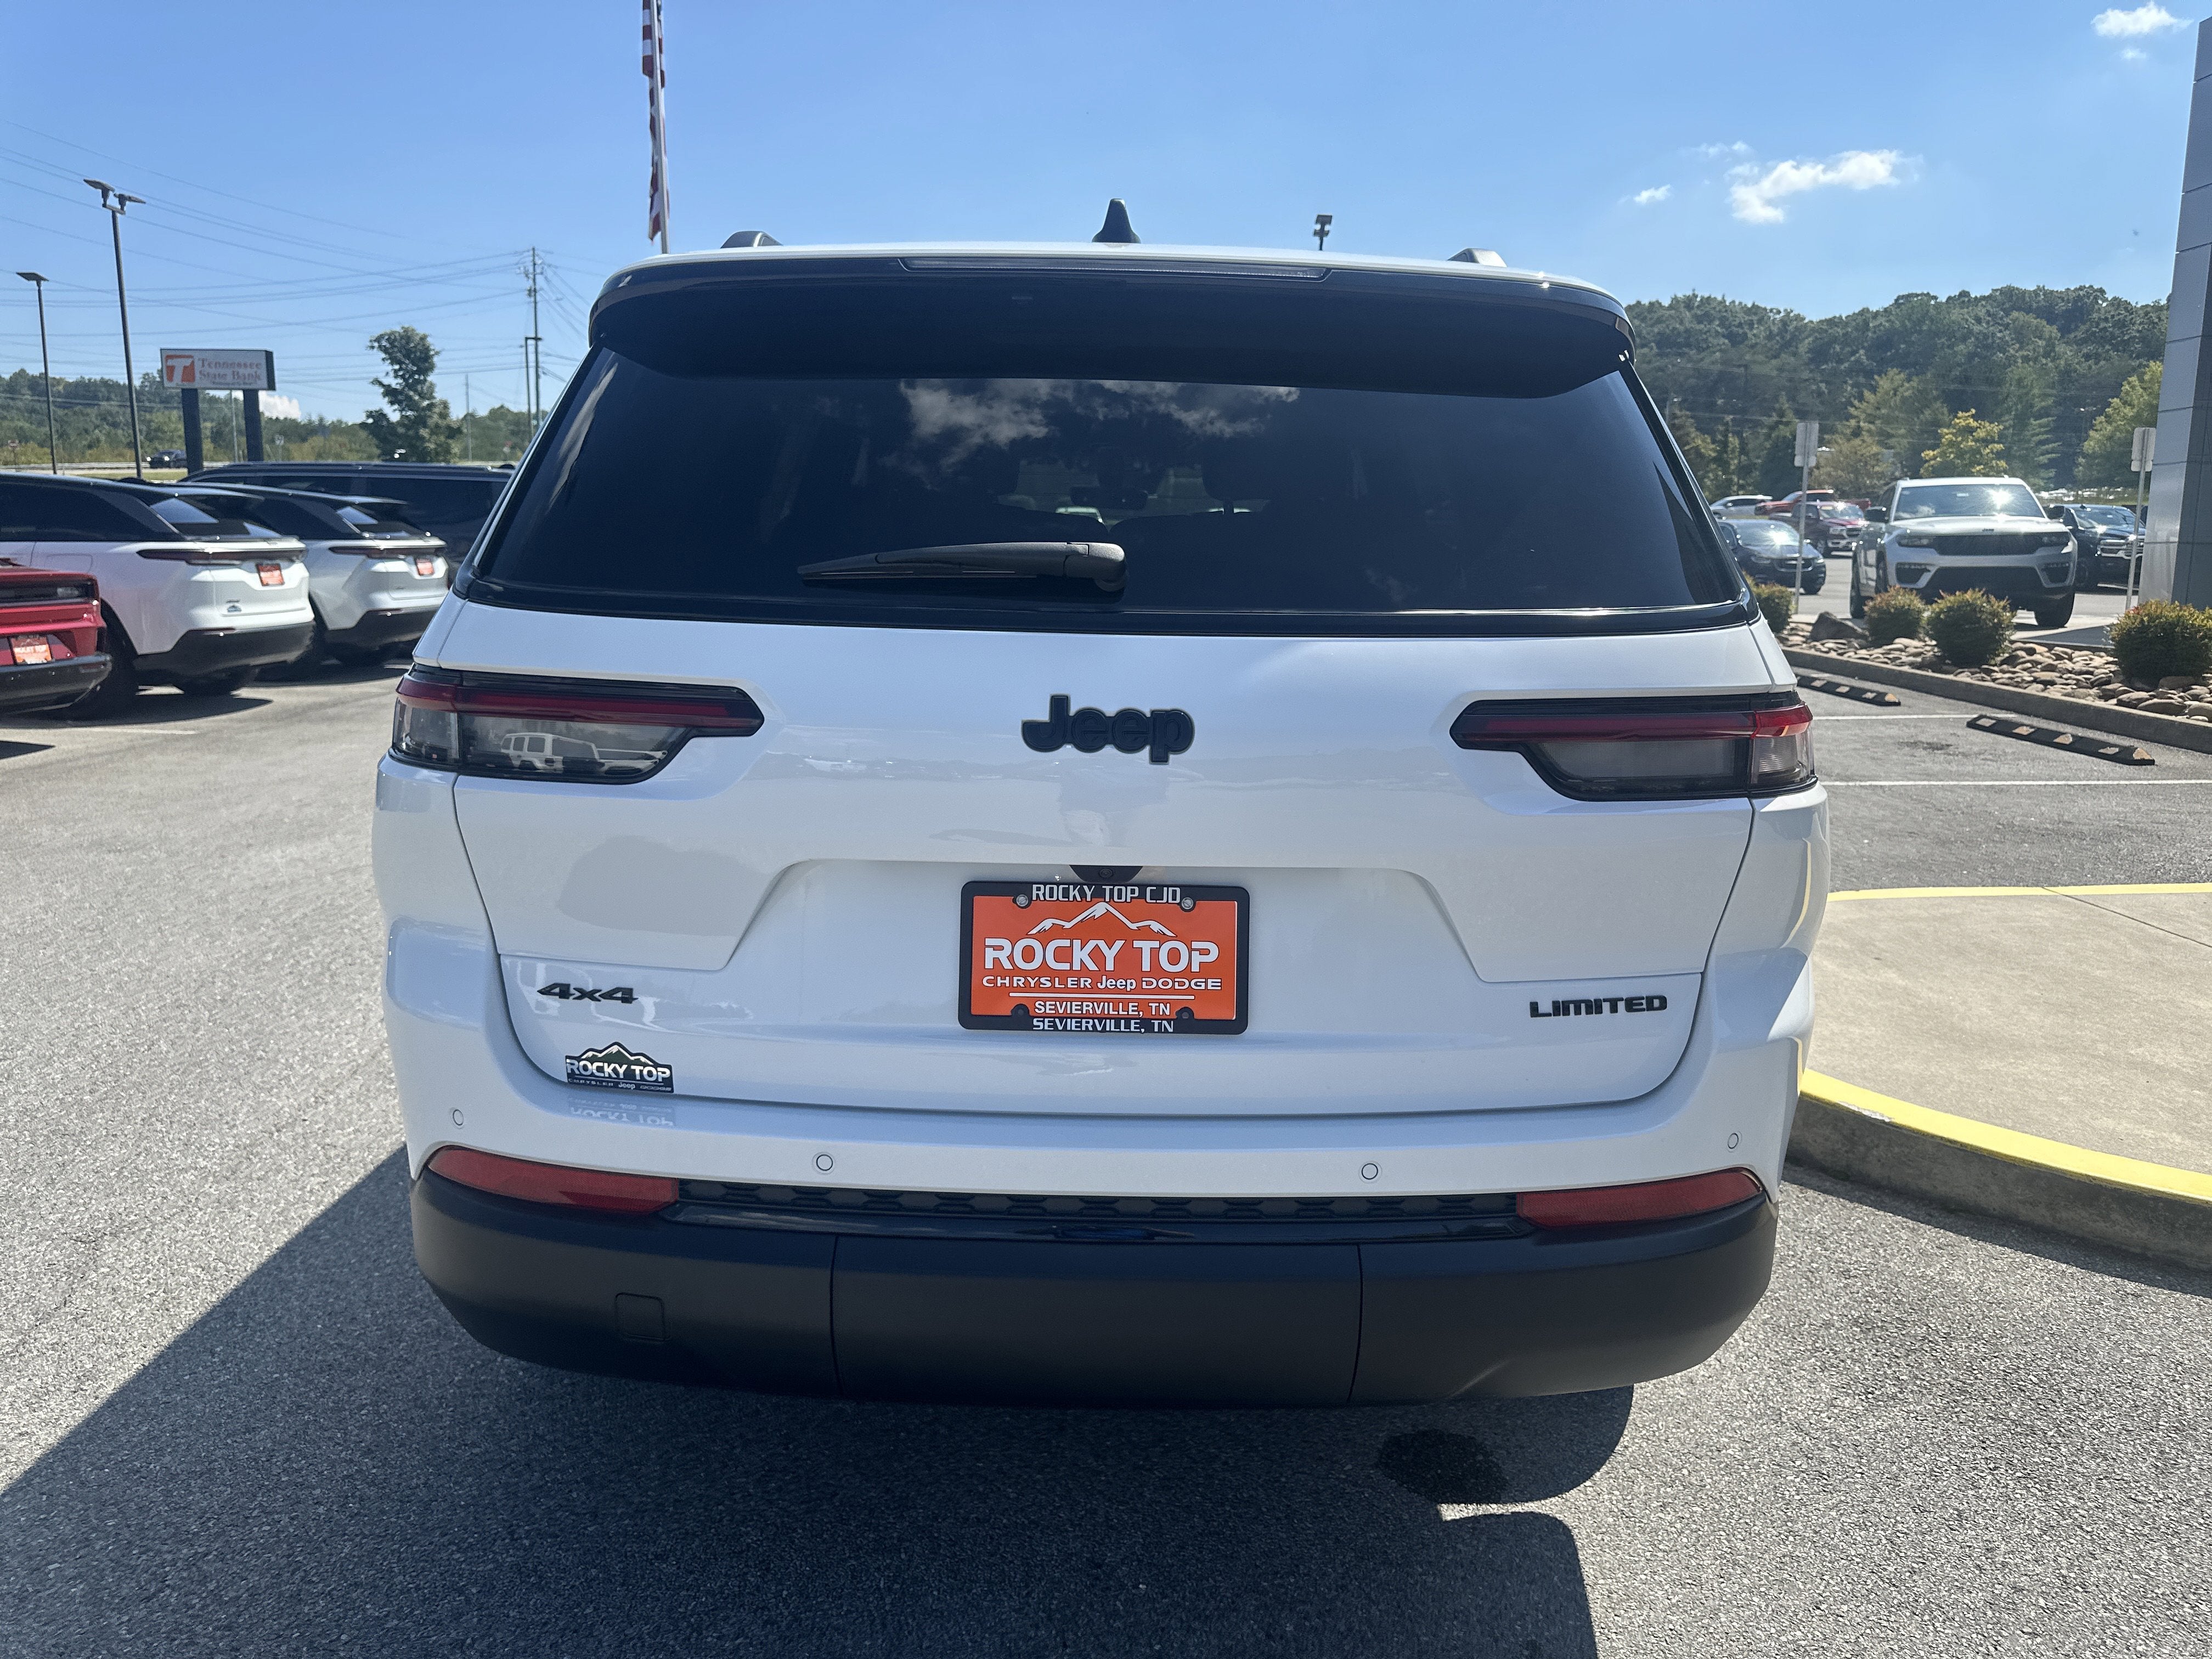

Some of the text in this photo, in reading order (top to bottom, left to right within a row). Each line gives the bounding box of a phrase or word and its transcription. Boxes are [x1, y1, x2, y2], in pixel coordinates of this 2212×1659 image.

[198, 358, 262, 369] Tennessee
[199, 369, 262, 380] State Bank
[1022, 694, 1195, 765] Jeep
[1032, 884, 1181, 905] ROCKY TOP CJD
[984, 938, 1220, 973] ROCKY TOP
[982, 975, 1222, 992] CHRYSLER Jeep DODGE
[537, 983, 639, 1004] 4x4
[1034, 1001, 1171, 1018] SEVIERVILLE, TN
[1530, 995, 1668, 1018] LIMITED
[1032, 1018, 1174, 1032] SEVIERVILLE, TN
[566, 1059, 671, 1082] ROCKY TOP
[568, 1078, 614, 1086] CHRYSLER
[618, 1082, 636, 1090] Jeep
